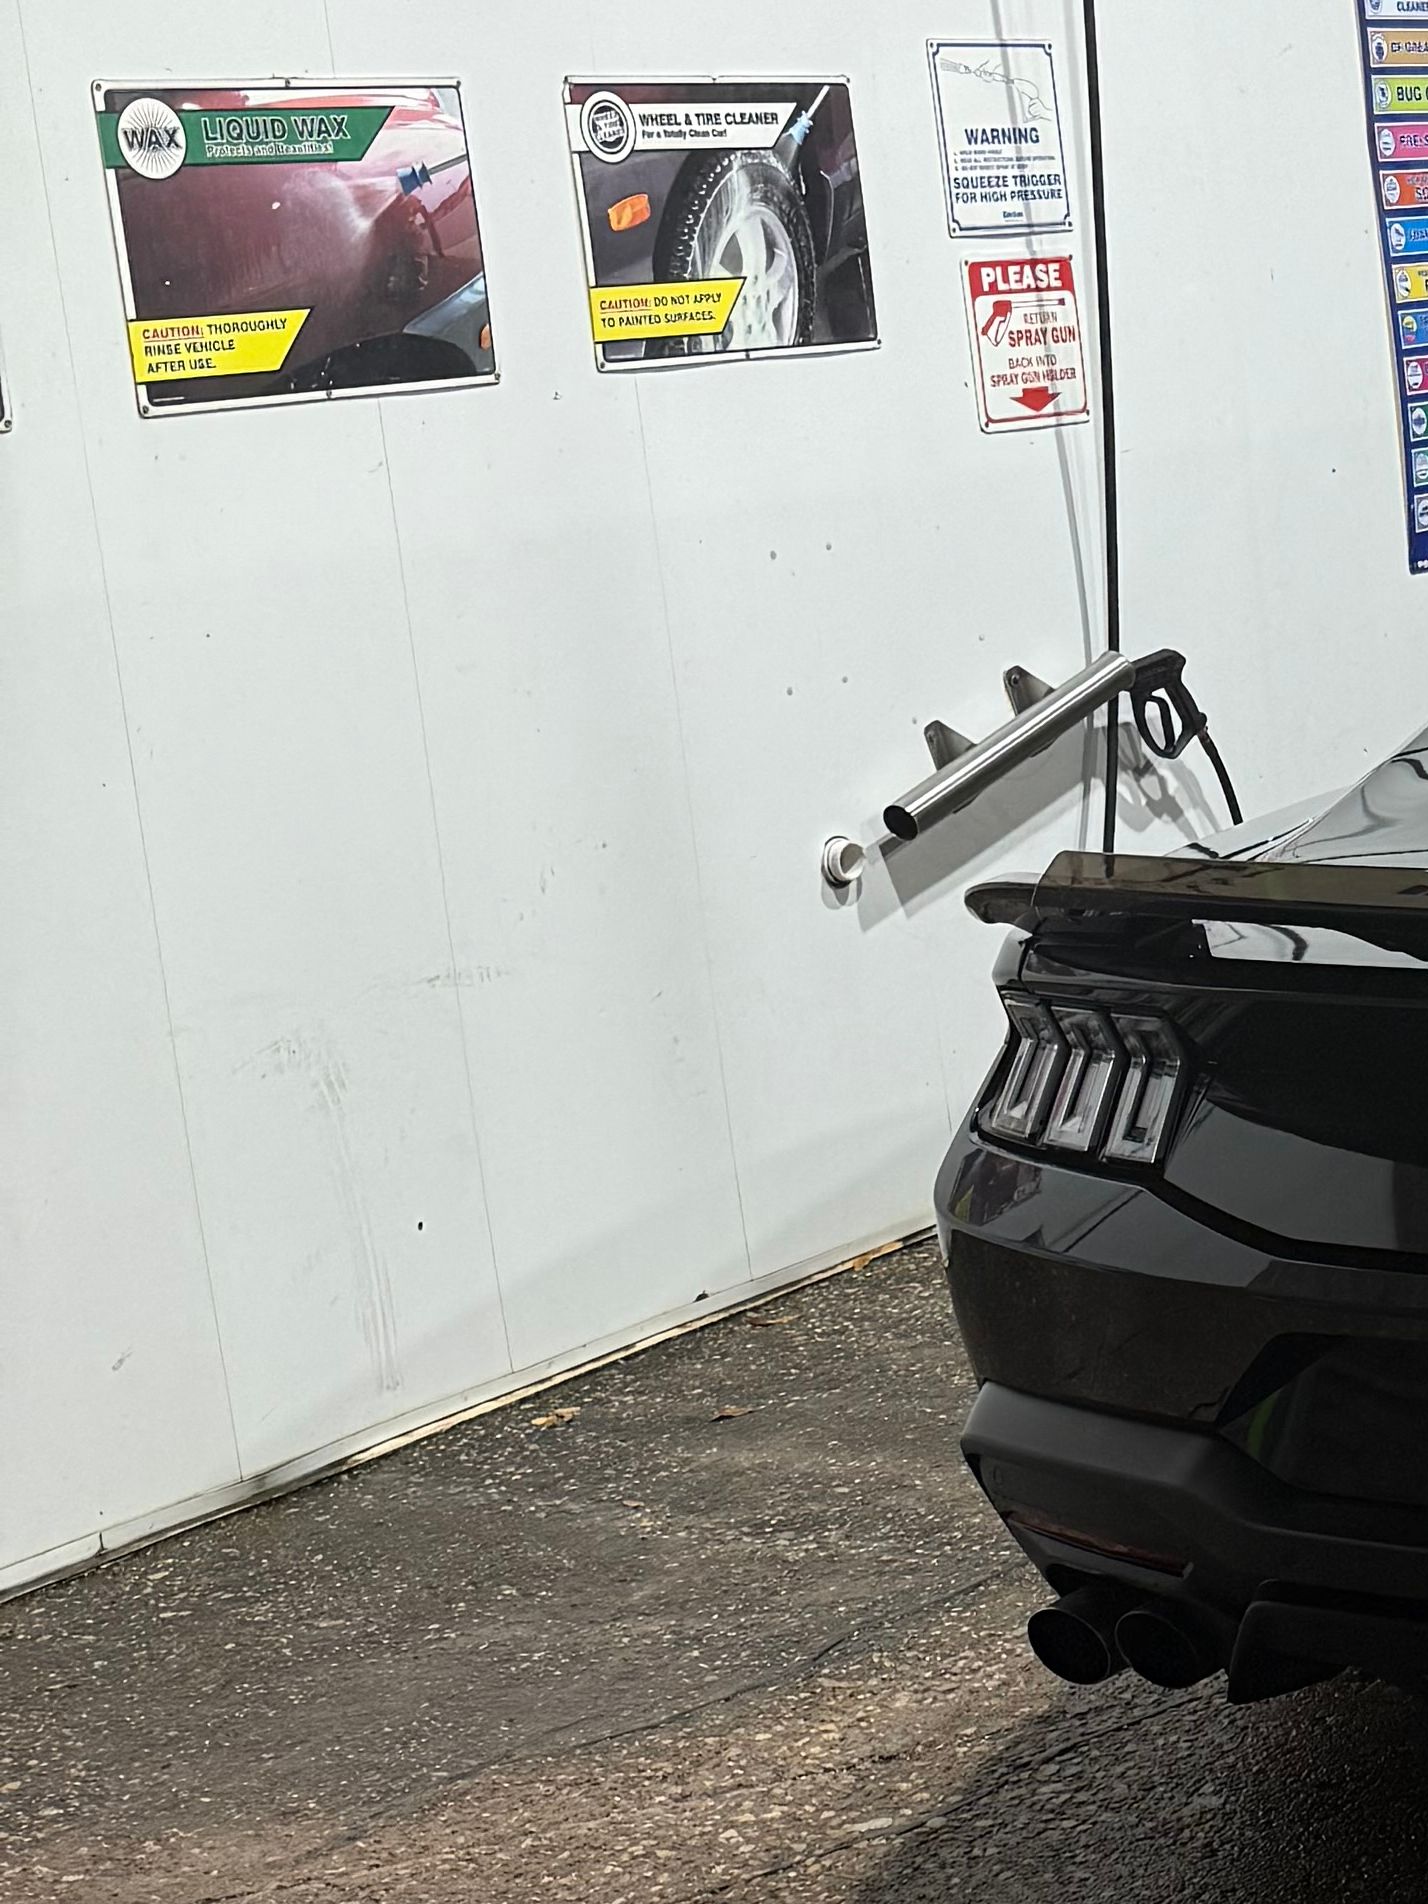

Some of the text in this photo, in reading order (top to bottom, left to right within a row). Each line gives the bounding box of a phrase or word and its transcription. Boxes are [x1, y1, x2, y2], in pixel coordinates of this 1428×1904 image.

[1397, 86, 1421, 102] BUG
[639, 114, 681, 126] WHEEL
[695, 113, 721, 125] TIRE
[725, 112, 779, 125] CLEANER
[202, 115, 351, 142] LIQUID WAX
[964, 127, 1040, 146] WARNING
[123, 127, 182, 152] WAX
[953, 174, 1061, 189] SQUEEZE TRIGGER
[955, 189, 1063, 204] FOR HIGH PRESSURE
[981, 263, 1062, 291] PLEASE
[654, 296, 668, 307] DO
[671, 294, 690, 305] NOT
[693, 293, 721, 304] APPLY
[601, 317, 615, 328] TO
[619, 315, 662, 327] PAINTED
[1023, 312, 1057, 324] RETURN
[207, 318, 288, 335] THOROUGHLY
[1008, 325, 1075, 347] SPRAY GUN
[145, 339, 235, 357] RINSE VEHICLE
[147, 360, 185, 374] AFTER
[1008, 354, 1057, 369] BACK INTO
[990, 367, 1077, 388] SPRAY GUN HOLDER
